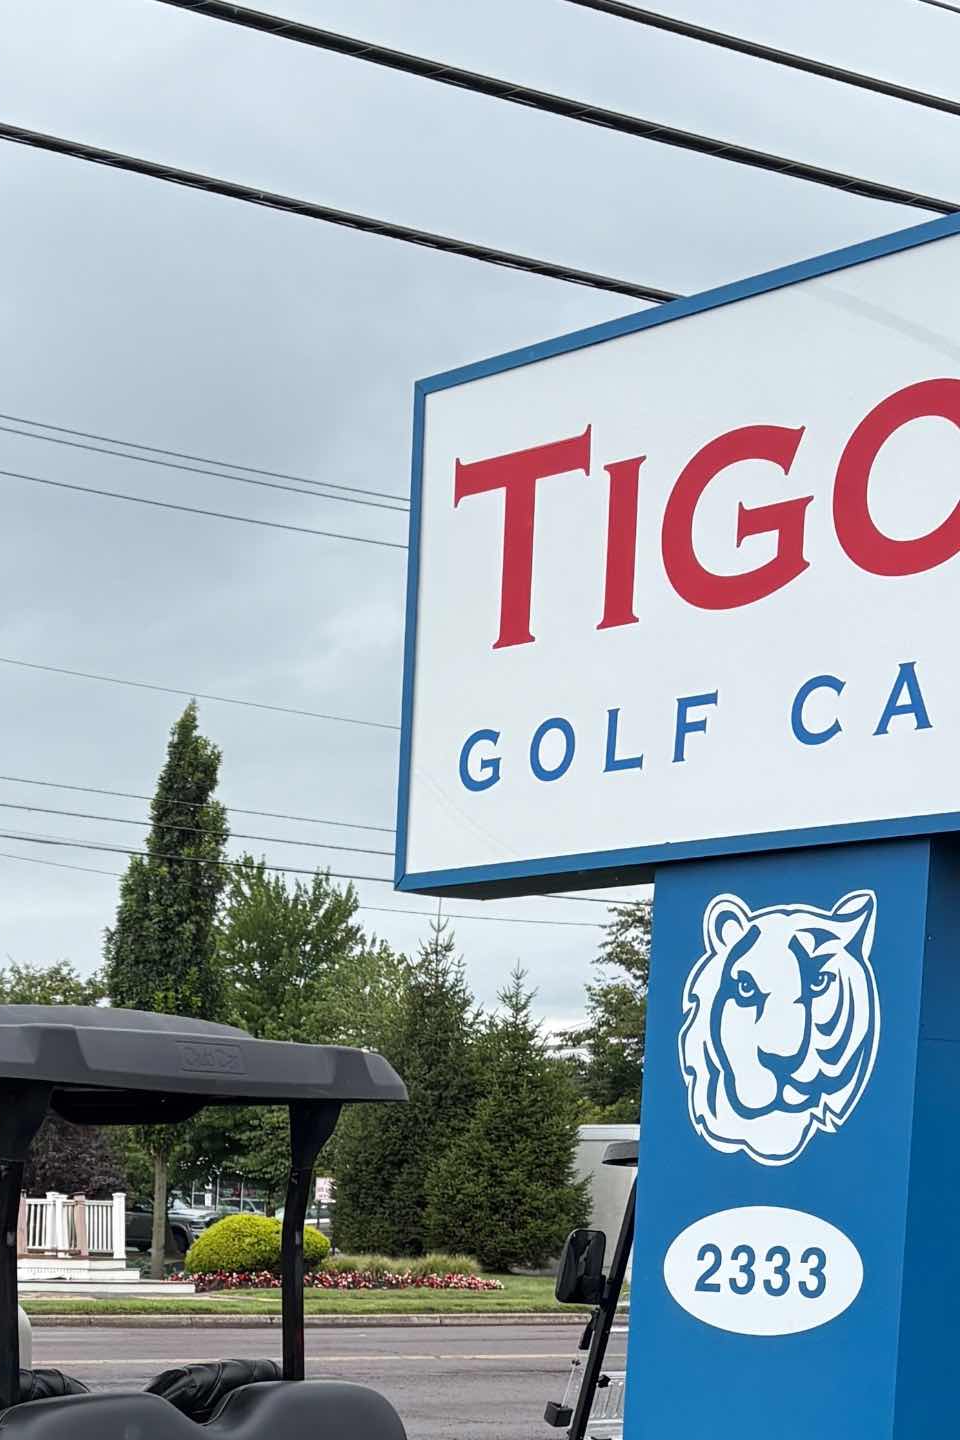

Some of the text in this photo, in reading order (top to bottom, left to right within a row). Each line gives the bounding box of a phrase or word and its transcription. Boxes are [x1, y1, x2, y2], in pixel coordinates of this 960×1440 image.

[453, 377, 960, 650] TIGO
[458, 661, 934, 792] GOLF CA
[694, 1243, 827, 1299] 2333
